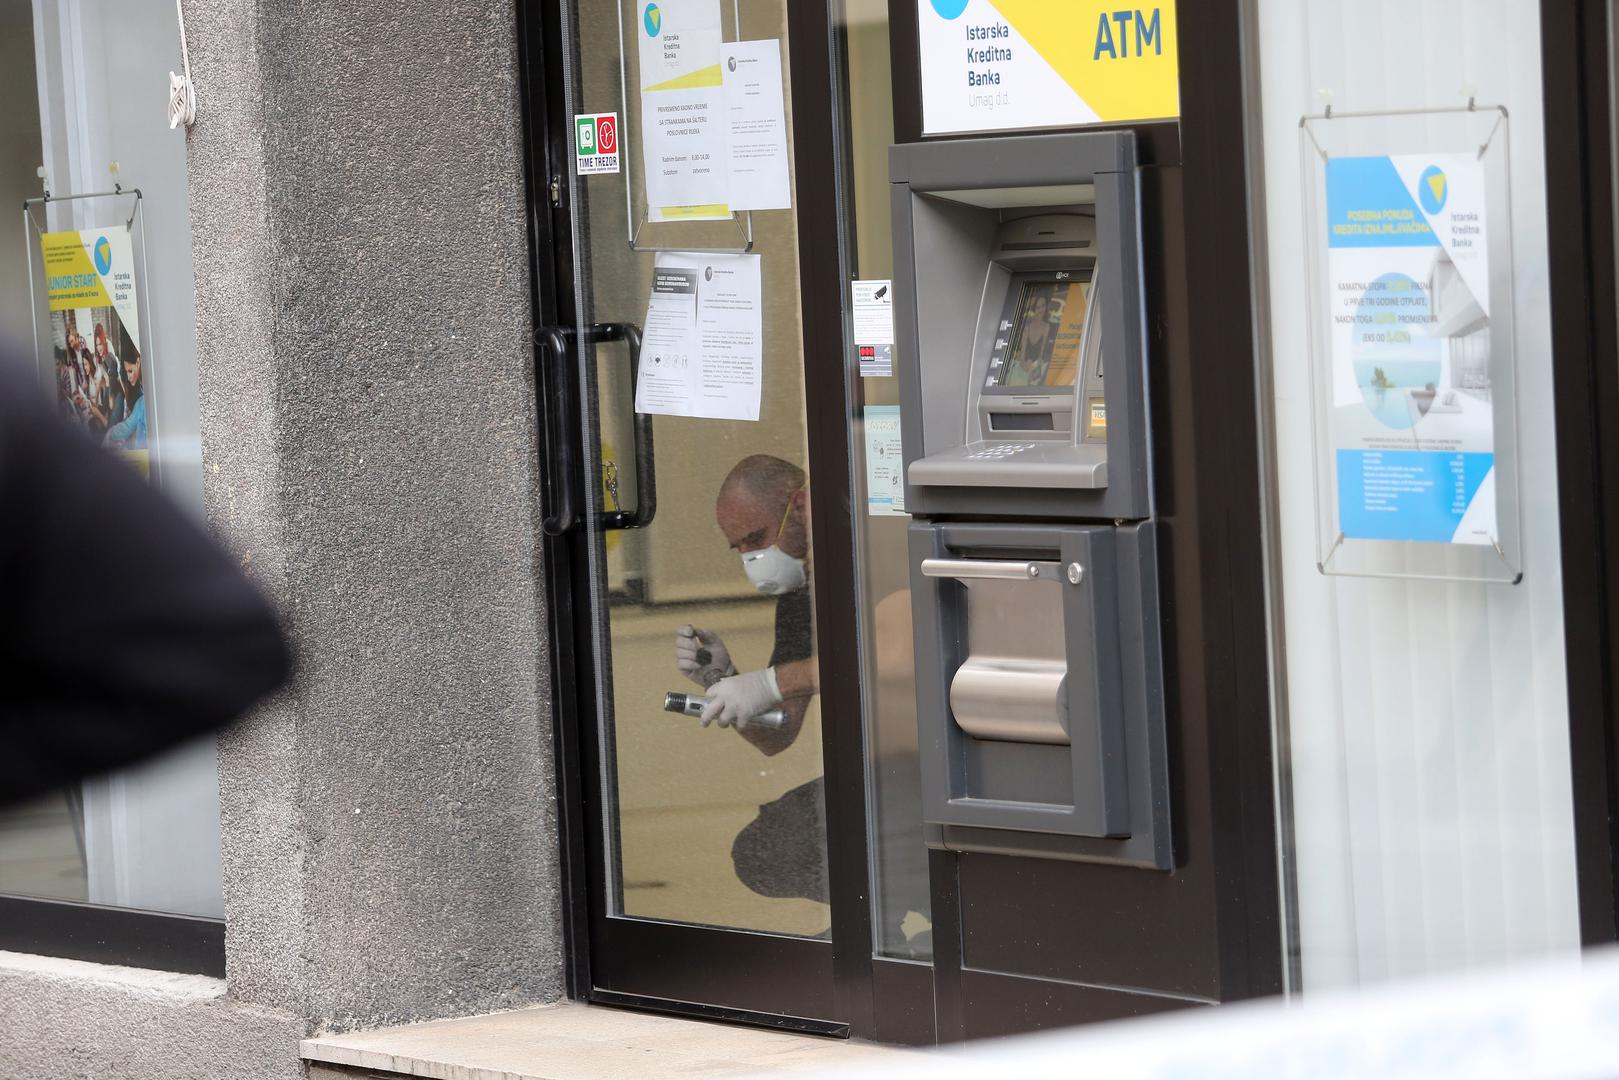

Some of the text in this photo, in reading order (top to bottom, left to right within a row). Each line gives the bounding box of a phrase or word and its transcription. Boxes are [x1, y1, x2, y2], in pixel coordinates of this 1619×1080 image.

[966, 22, 1009, 41] Istarska
[1093, 8, 1162, 61] ATM
[664, 43, 680, 51] Kreditna
[967, 46, 1012, 64] Kreditna
[968, 69, 1000, 87] Banka
[968, 93, 994, 110] Umag
[579, 156, 617, 168] TIME TREZOR
[1451, 213, 1478, 222] Istarska
[1451, 224, 1480, 234] Kreditna
[1452, 238, 1472, 248] Banka
[48, 273, 97, 290] JUNIOR START
[114, 272, 130, 280] Istarska
[1376, 297, 1399, 306] GODINE
[1356, 315, 1373, 324] TOGA
